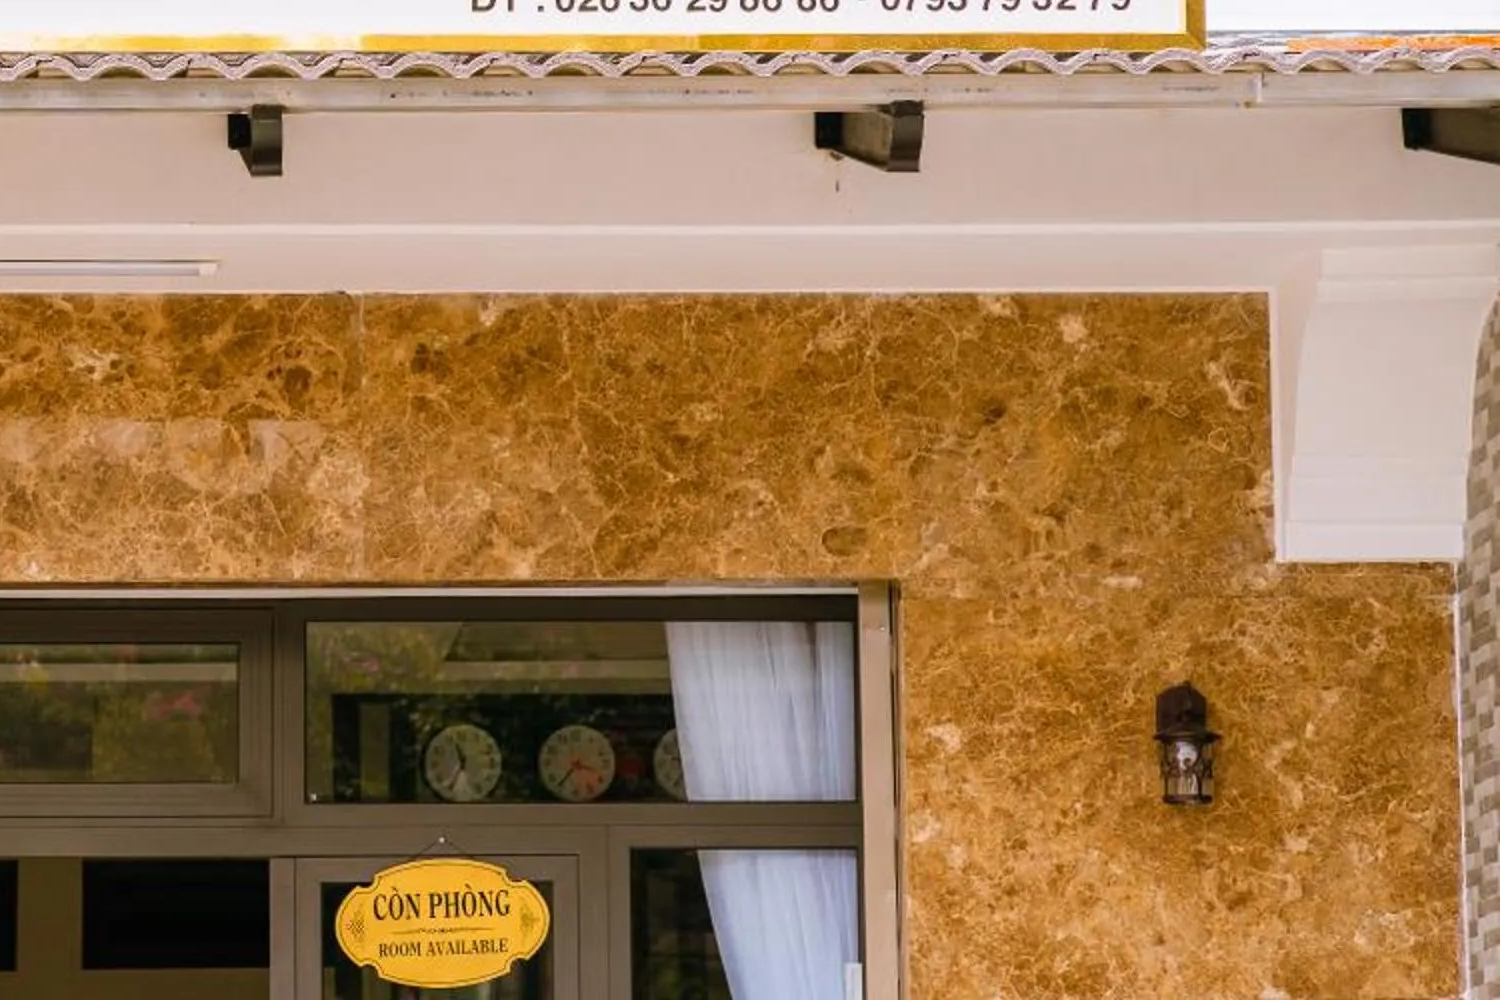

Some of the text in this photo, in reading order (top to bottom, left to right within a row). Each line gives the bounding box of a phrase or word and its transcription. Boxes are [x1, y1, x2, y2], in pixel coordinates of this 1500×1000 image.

[373, 883, 511, 921] CÒN PHÒNG
[379, 937, 509, 958] ROOM AVAILABLE
